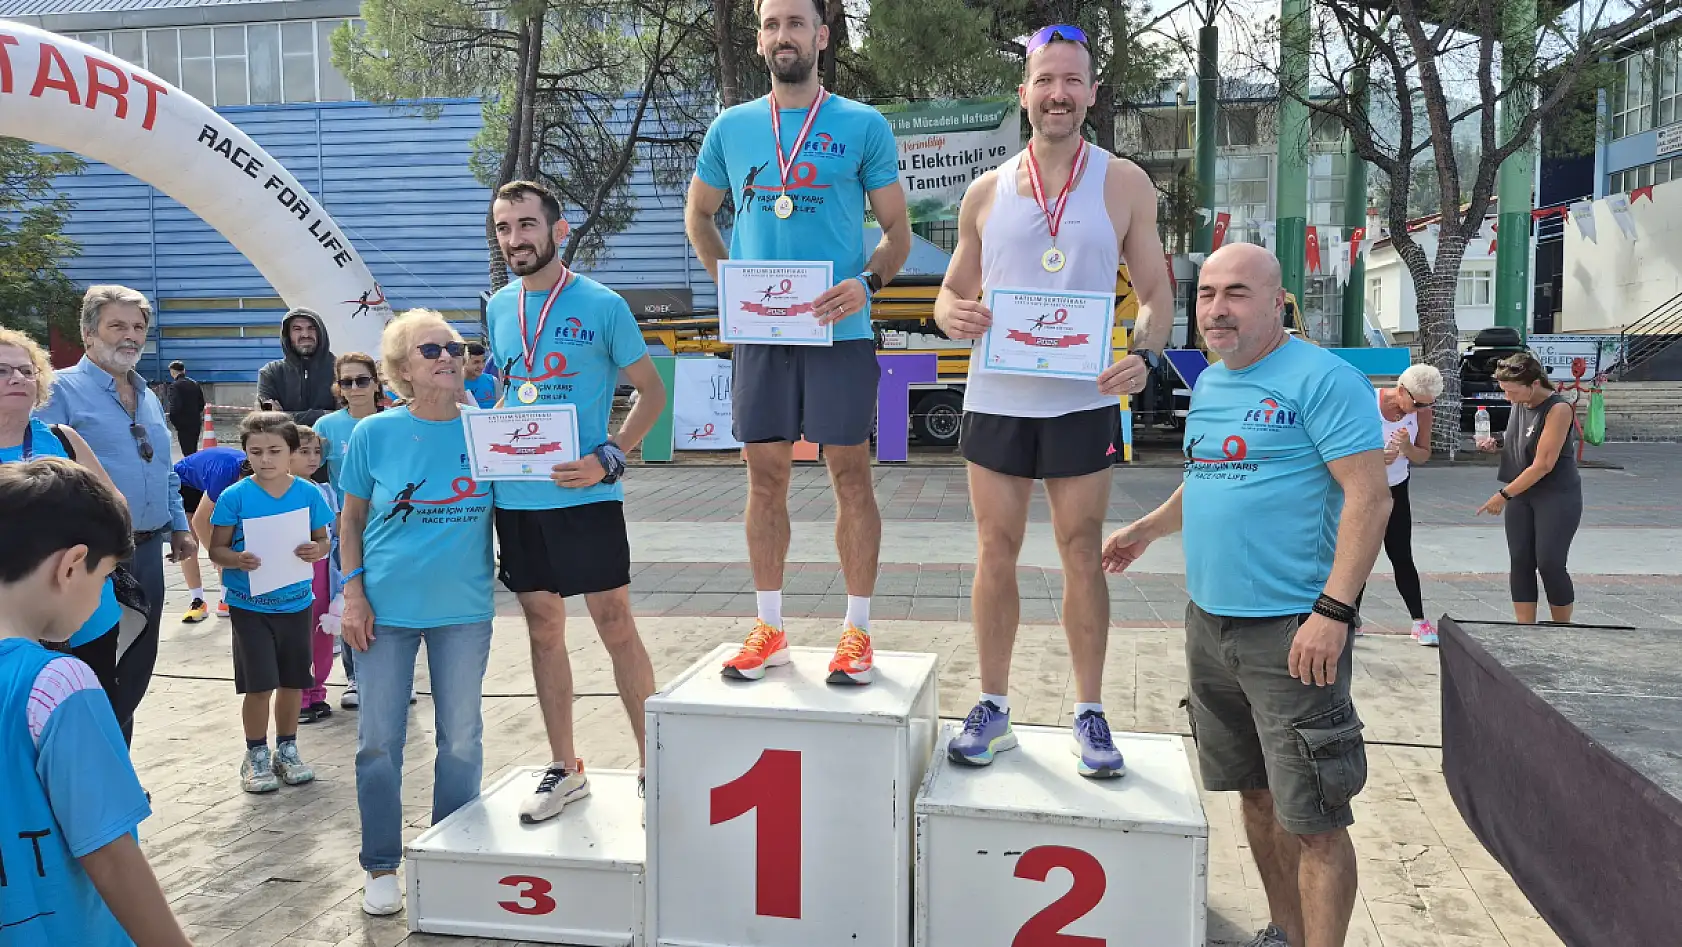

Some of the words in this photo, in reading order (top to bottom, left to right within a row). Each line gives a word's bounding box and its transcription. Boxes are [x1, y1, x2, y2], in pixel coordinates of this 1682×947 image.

[0, 34, 168, 131] TART
[913, 114, 959, 129] Mücadele
[804, 140, 846, 155] FETAV
[912, 148, 983, 170] Elektrikli
[988, 145, 1006, 158] ve
[197, 124, 265, 179] RACE
[263, 174, 311, 221] FOR
[308, 219, 353, 268] LIFE
[554, 327, 595, 341] FETAV
[1243, 409, 1297, 425] FETAV
[1231, 463, 1258, 472] YARIŞ
[709, 750, 802, 919] 1
[498, 875, 555, 915] 3
[1013, 845, 1107, 947] 2
